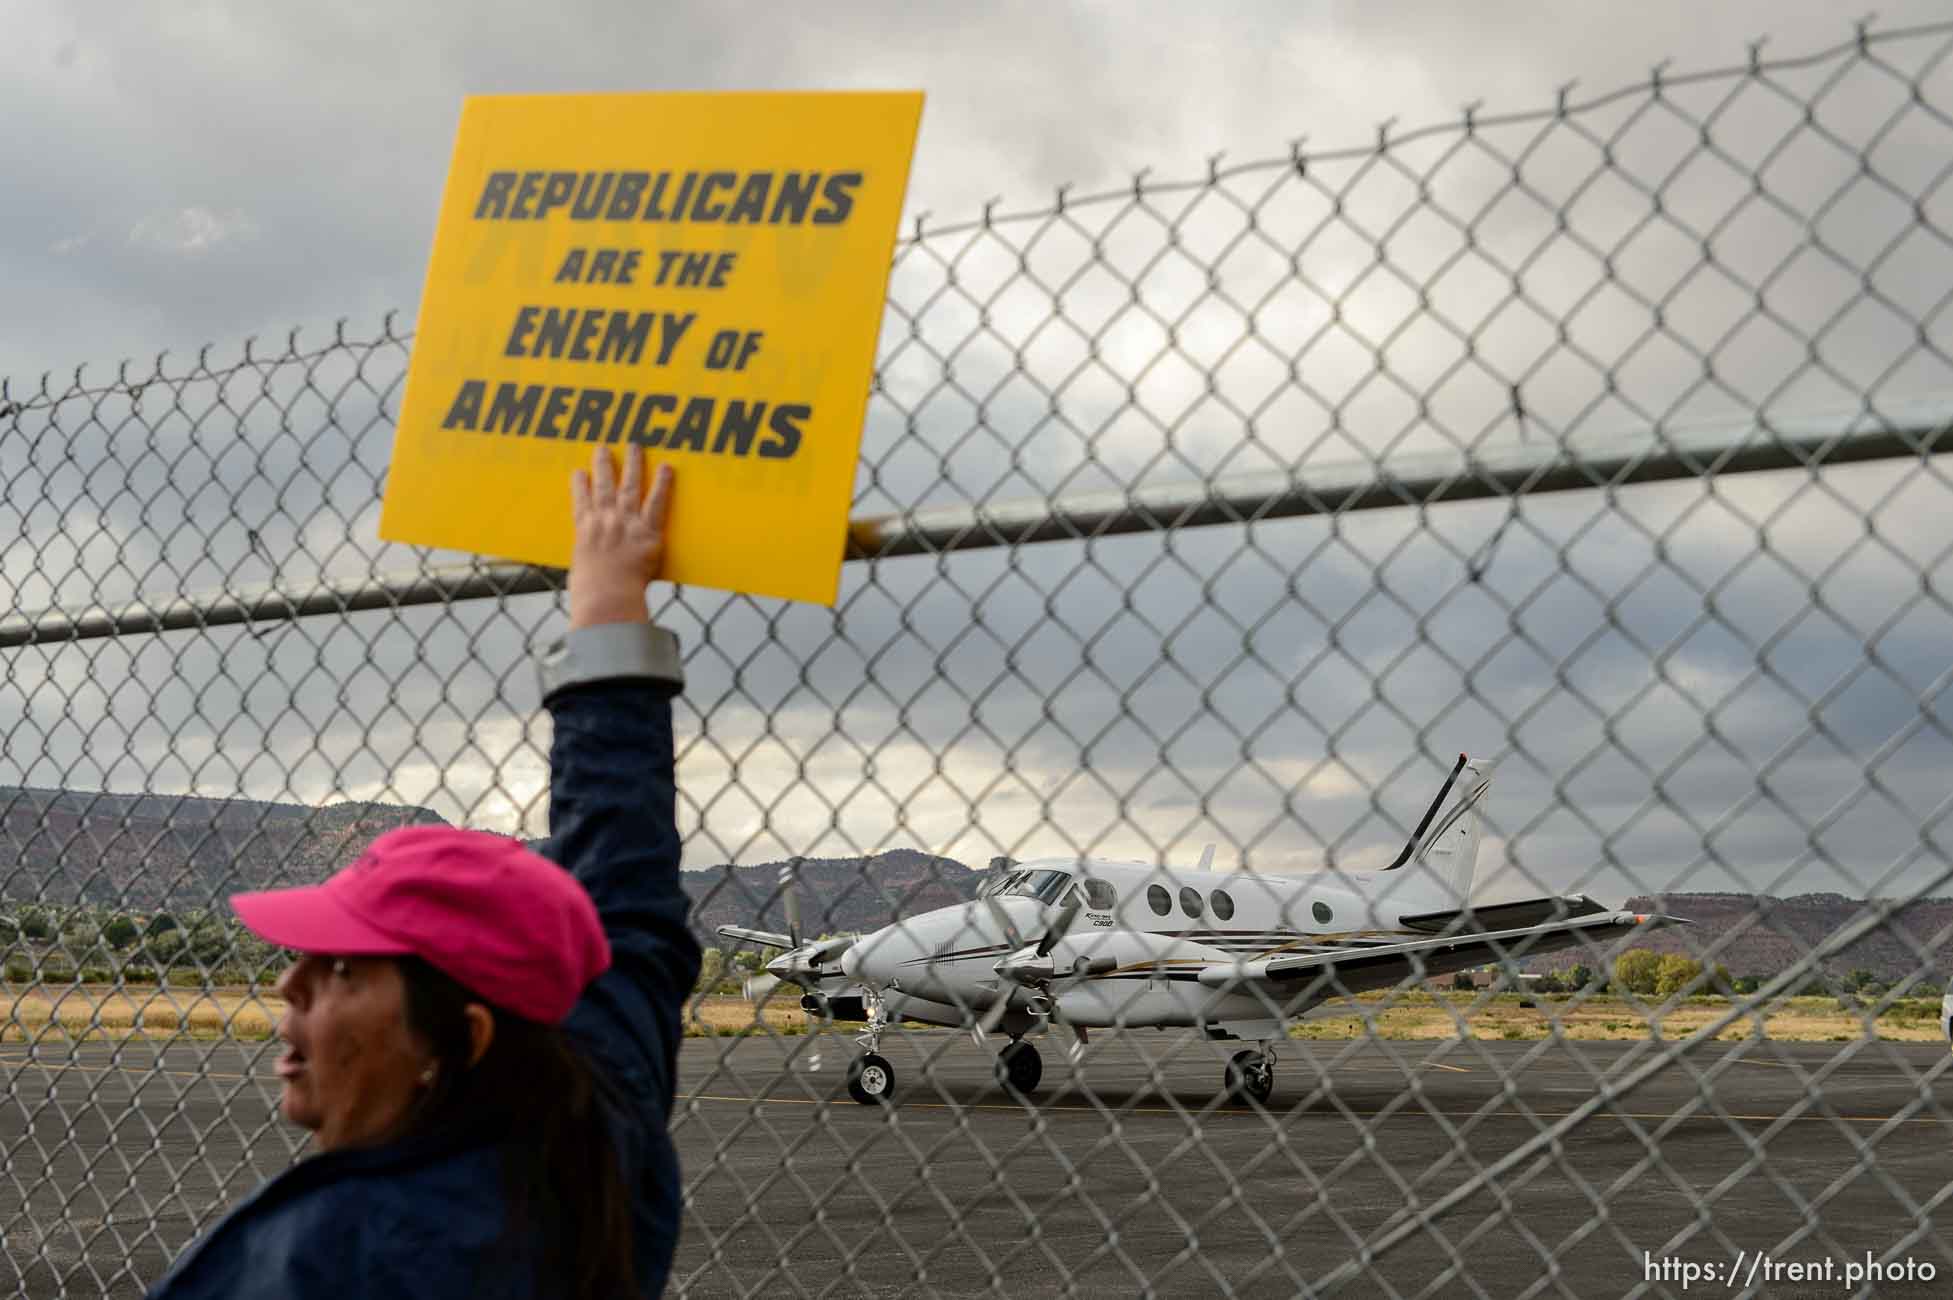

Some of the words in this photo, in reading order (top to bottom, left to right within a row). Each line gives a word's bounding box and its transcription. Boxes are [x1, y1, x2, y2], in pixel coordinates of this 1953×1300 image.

[474, 171, 864, 225] REPUBLICANS
[554, 248, 642, 286] ARE
[654, 250, 737, 288] THE
[503, 306, 697, 367] ENEMY
[704, 329, 764, 372] OF
[441, 379, 812, 460] AMERICANS
